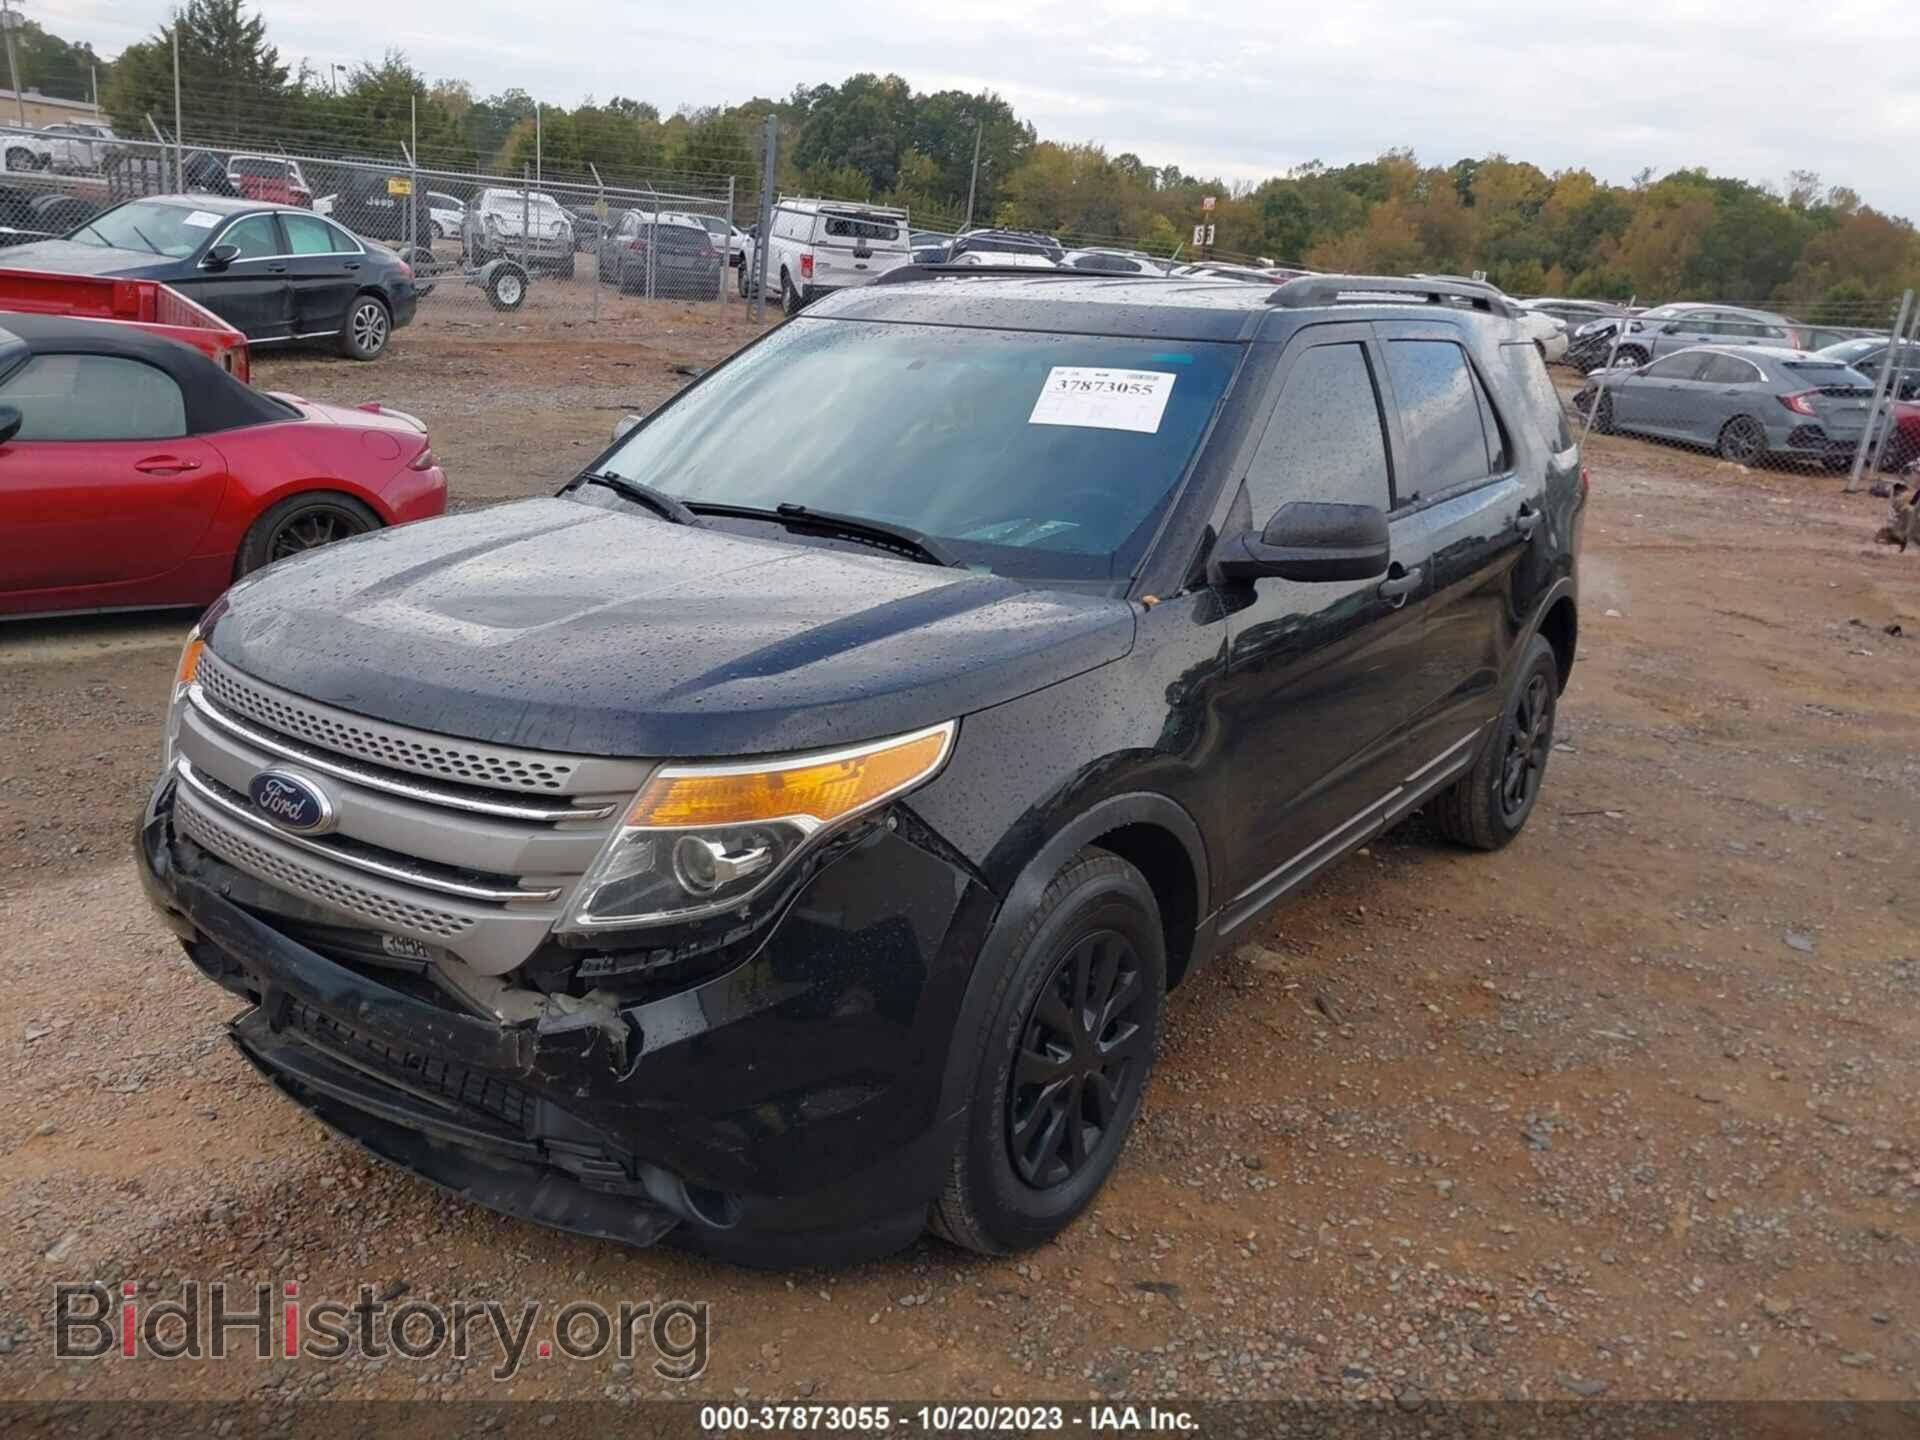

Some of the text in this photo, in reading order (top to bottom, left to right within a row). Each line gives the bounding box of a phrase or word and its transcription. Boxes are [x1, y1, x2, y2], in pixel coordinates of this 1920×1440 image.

[366, 196, 394, 208] Jeep
[1055, 379, 1154, 396] 37873055
[260, 779, 306, 820] Ford
